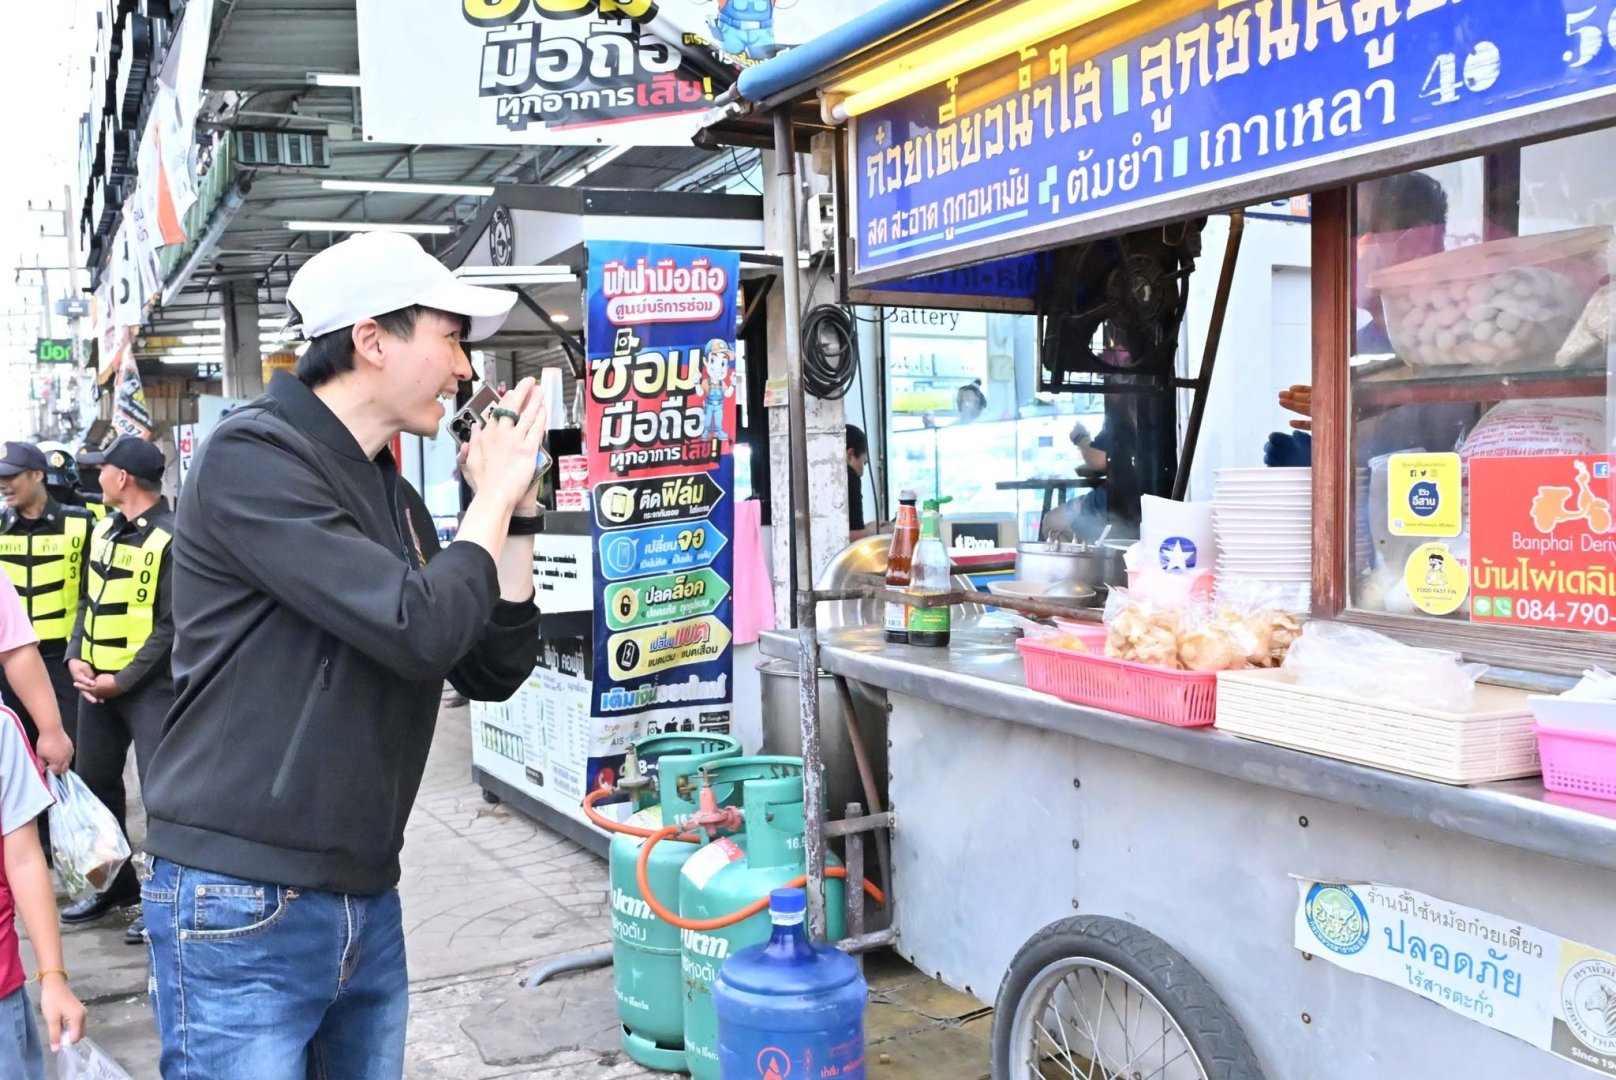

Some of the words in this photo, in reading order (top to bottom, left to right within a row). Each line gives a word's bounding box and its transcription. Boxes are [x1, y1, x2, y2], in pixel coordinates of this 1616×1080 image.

[480, 19, 683, 92] มือถือ
[1066, 132, 1163, 205] ต้มยำ
[1199, 78, 1396, 171] เกาเหลา
[1418, 40, 1501, 106] 40
[1562, 2, 1616, 68] 5
[868, 217, 888, 246] สด
[891, 201, 938, 239] สะอาด
[943, 167, 1029, 241] ถูกอนามัย
[615, 296, 713, 319] ศูนย์บริการซ่อม
[600, 396, 706, 448] มือถือ
[639, 476, 704, 510] ติดฟิล์ม
[644, 527, 706, 554] เปลี่ยนจอ
[1512, 531, 1573, 555] Banphai
[645, 575, 705, 605] ปลดล็อค
[1367, 886, 1544, 959] ร้านนี้ใช้หม้อก๋วยเตี๋ยว
[1383, 919, 1522, 998] ปลอดภัย
[1405, 963, 1495, 1018] ไร้สารตะกั่ว
[1565, 999, 1588, 1038] ZEBRA
[1571, 1046, 1599, 1065] Since
